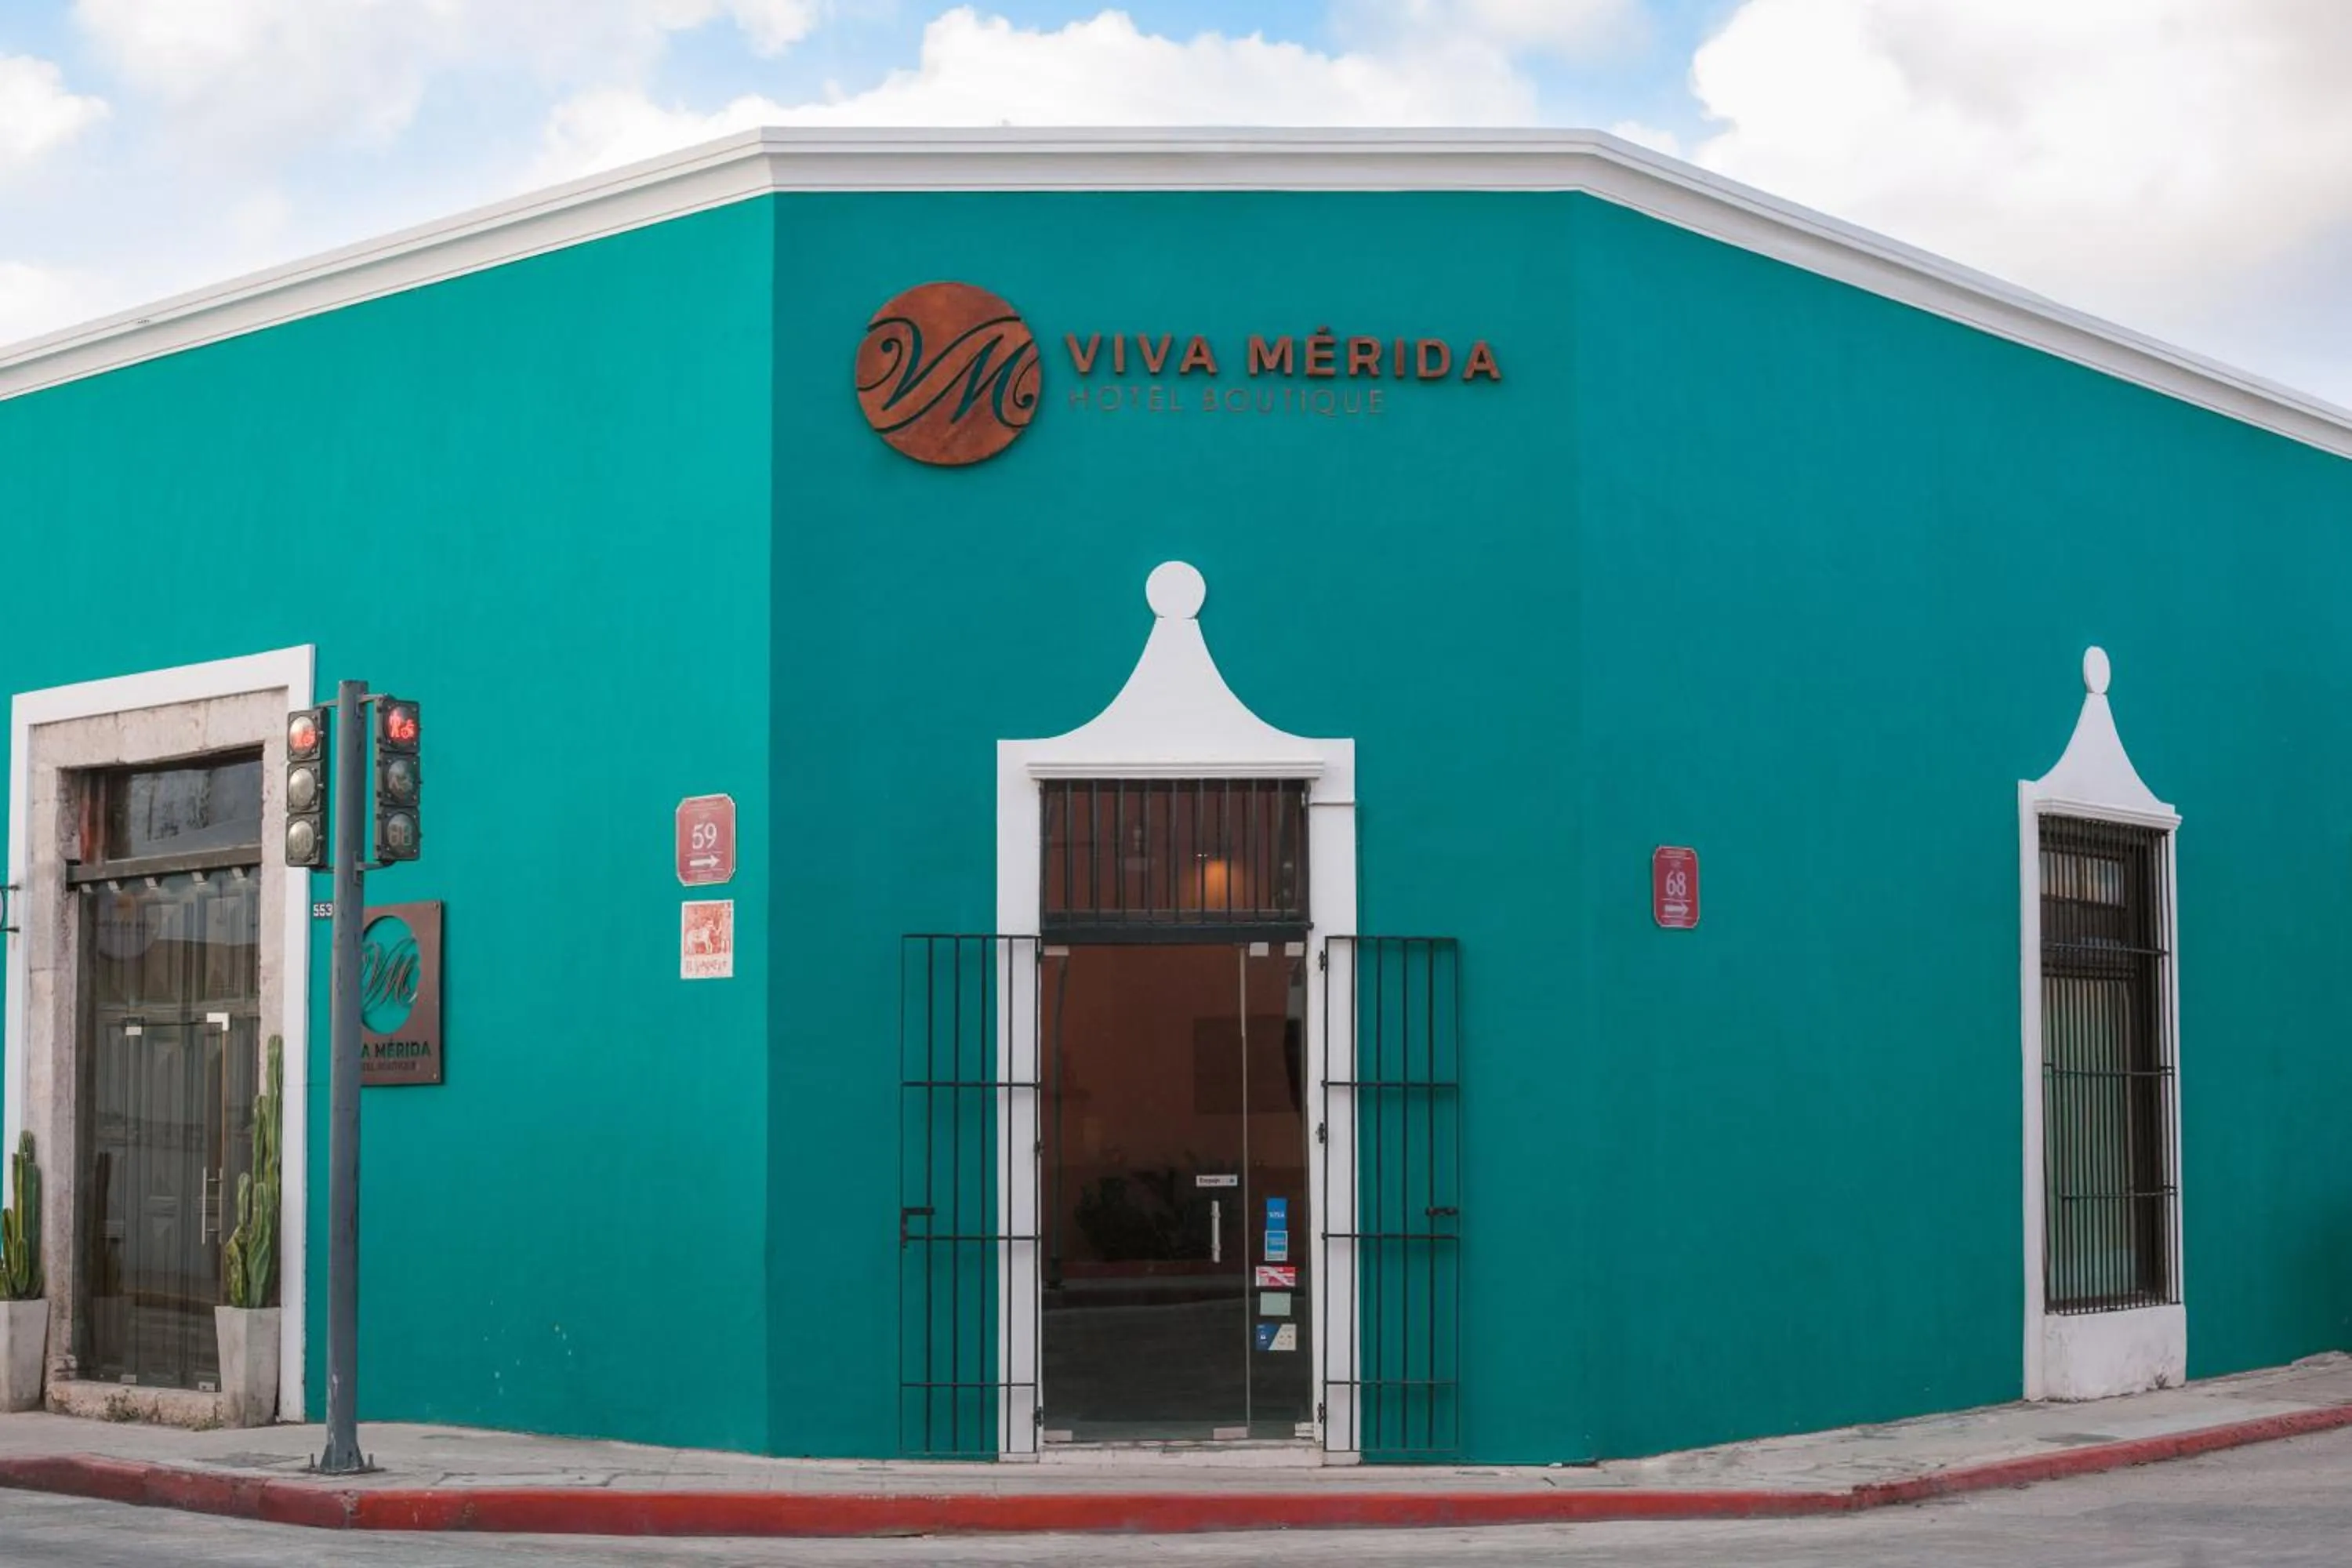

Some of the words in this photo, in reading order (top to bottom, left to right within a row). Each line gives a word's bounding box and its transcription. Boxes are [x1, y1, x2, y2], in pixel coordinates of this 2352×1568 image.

[1065, 332, 1218, 376] VIVA
[1247, 325, 1501, 381] MÉRIDA
[1069, 385, 1183, 412] HOTEL
[1203, 388, 1384, 417] BOUTIQUE
[691, 822, 717, 850] 59
[1666, 870, 1686, 896] 68
[314, 902, 333, 916] 553
